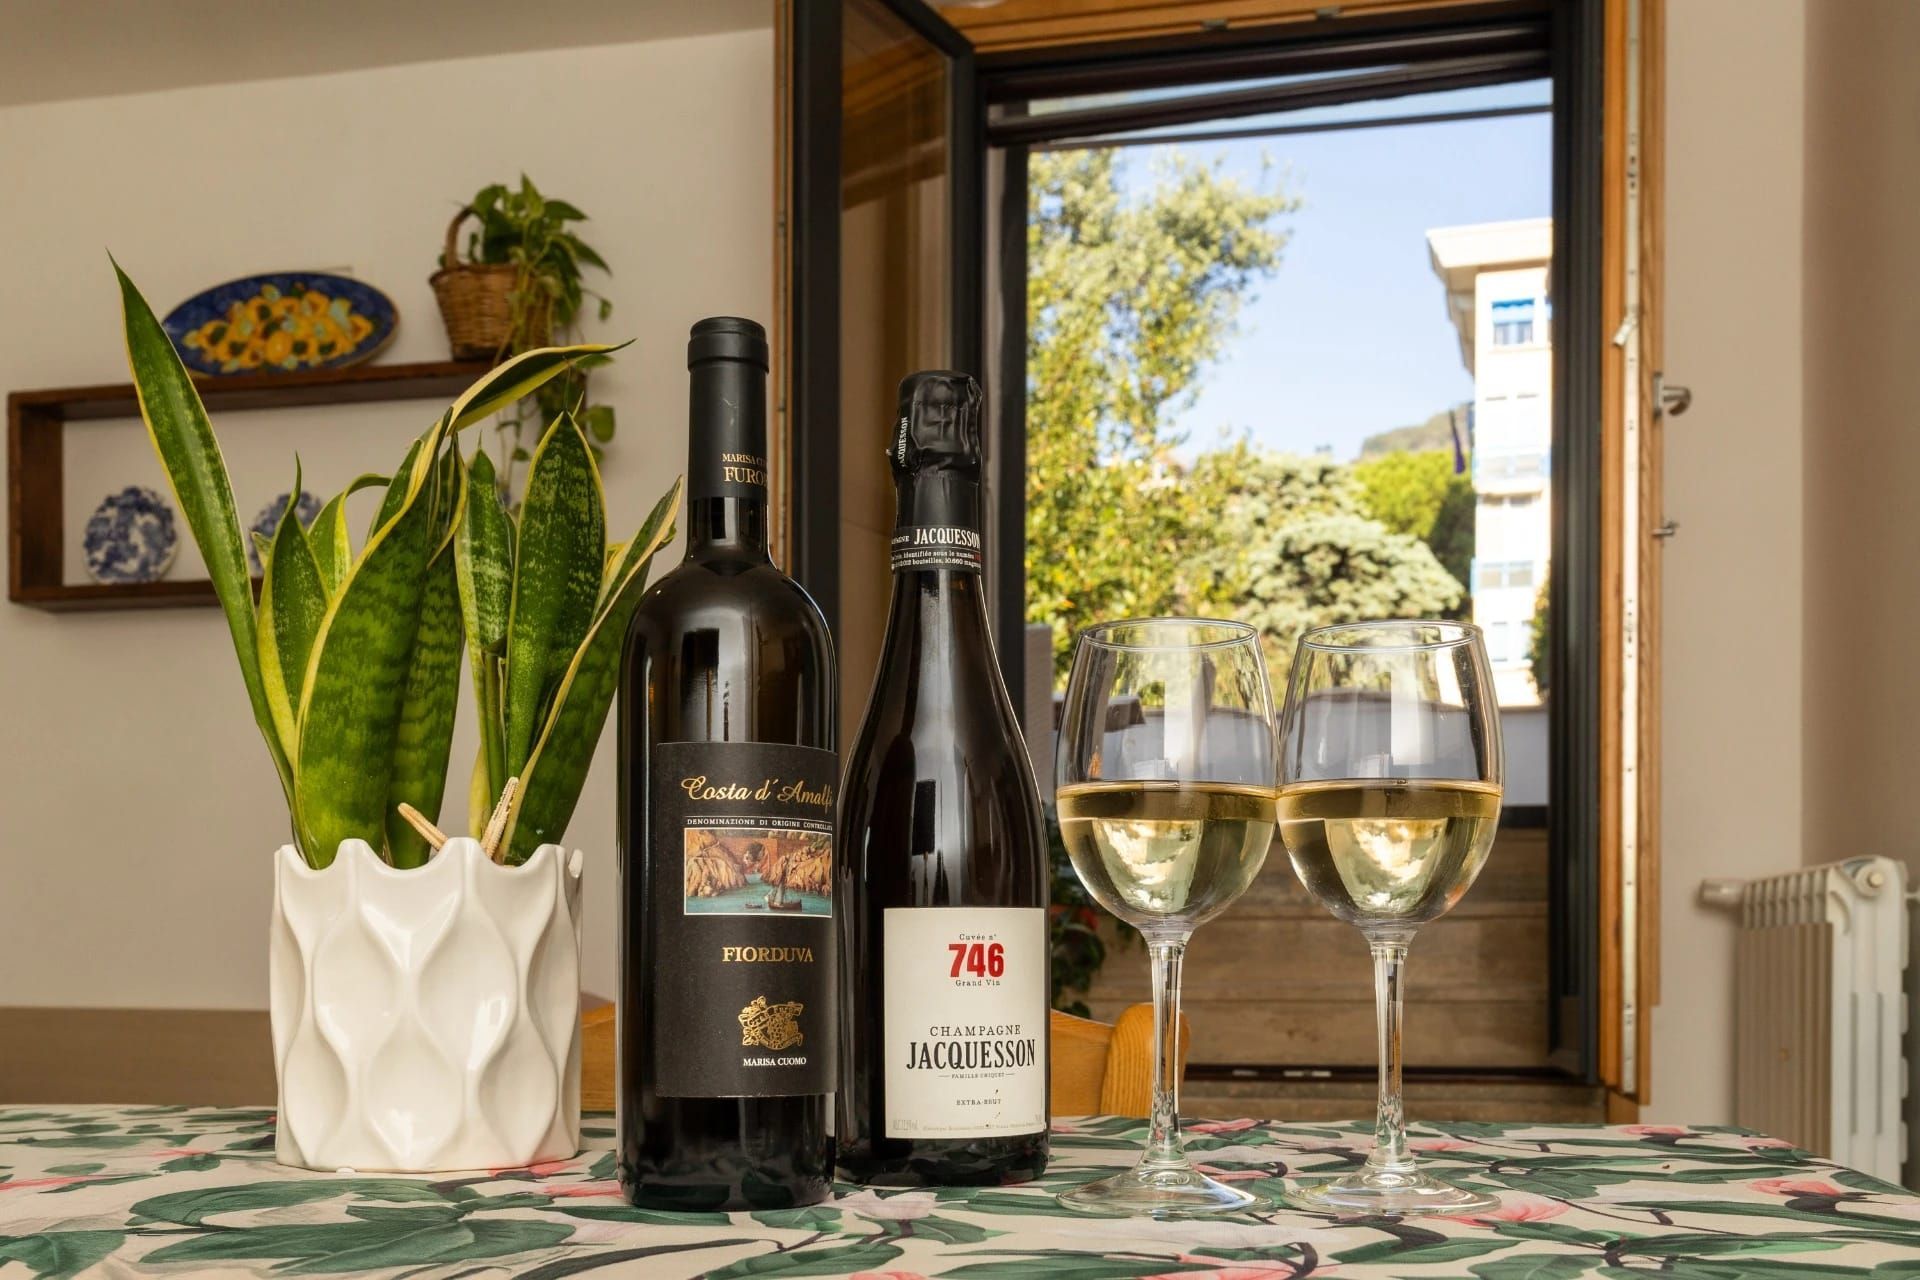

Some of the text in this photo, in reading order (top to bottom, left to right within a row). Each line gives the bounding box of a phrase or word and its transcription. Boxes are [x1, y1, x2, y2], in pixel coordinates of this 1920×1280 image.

[722, 453, 755, 464] MARISA
[723, 466, 767, 487] FURO
[914, 527, 981, 549] JACQUESSON
[680, 775, 753, 801] Costa
[687, 818, 755, 826] DENOMINAZIONE
[772, 820, 801, 828] ORIGINE
[959, 933, 986, 941] Cuvée
[722, 946, 815, 963] FIORDUVA
[948, 943, 1004, 978] 746
[955, 979, 982, 987] Grand
[930, 1024, 1021, 1037] CHAMPAGNE
[743, 1056, 807, 1066] MARISA CUOMO
[906, 1038, 1036, 1070] JACQUESSON
